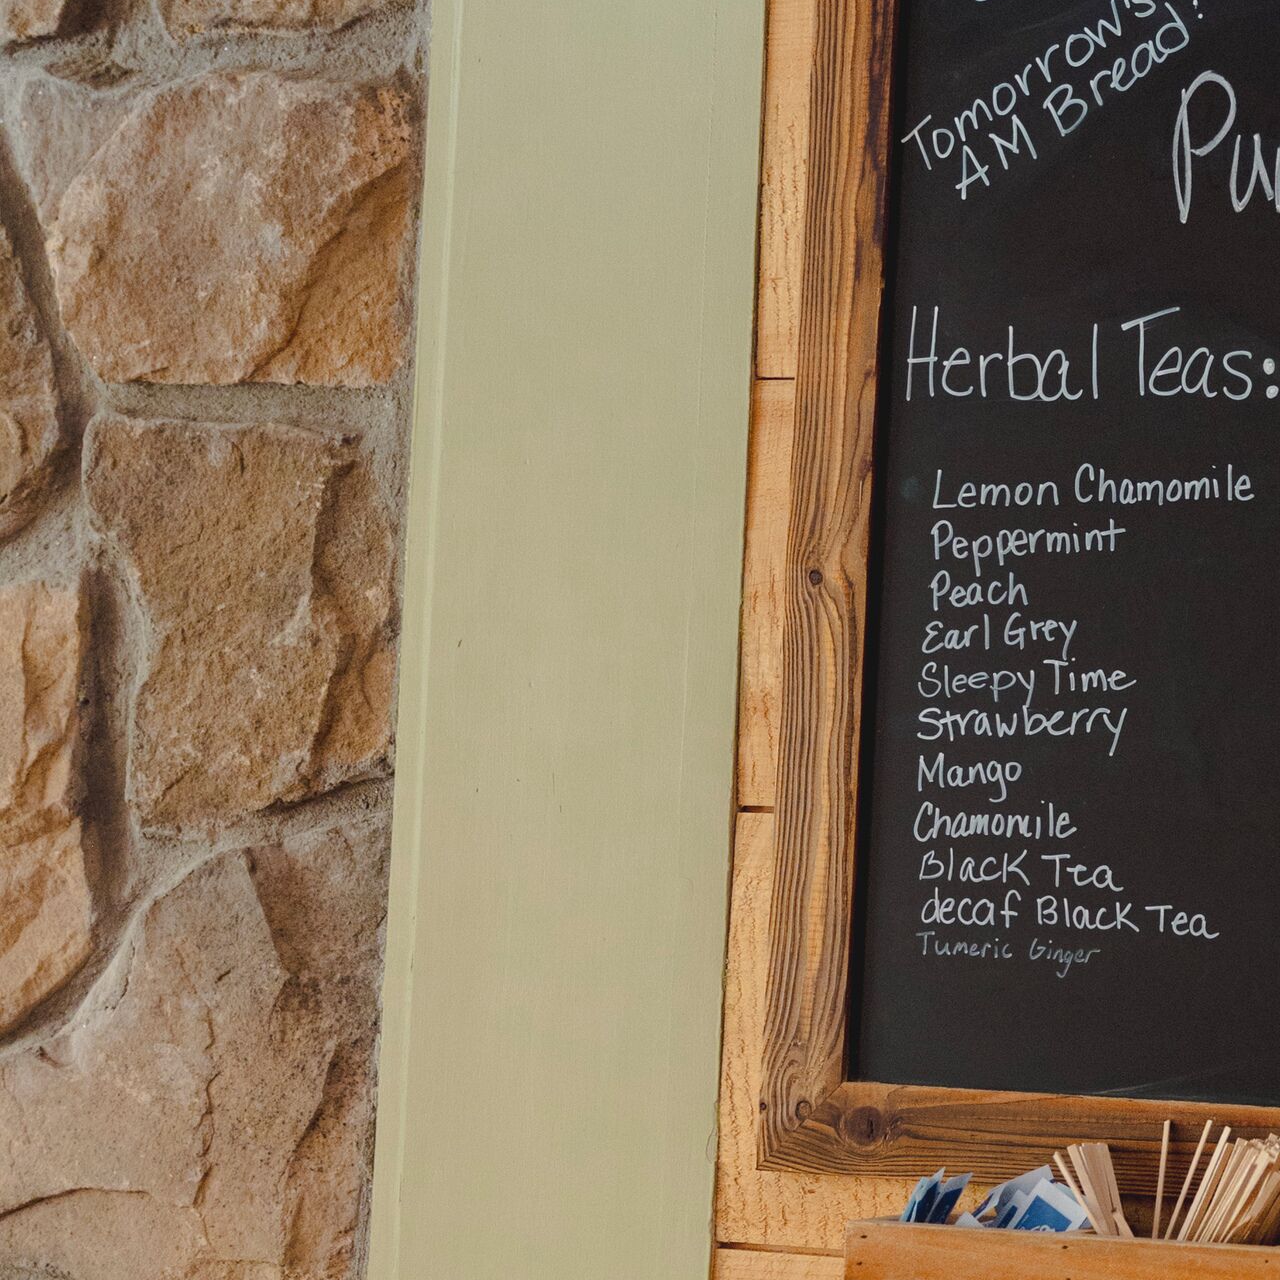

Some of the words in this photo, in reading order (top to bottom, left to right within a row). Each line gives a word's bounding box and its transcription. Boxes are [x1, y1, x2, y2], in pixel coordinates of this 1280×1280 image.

[954, 124, 1039, 200] AM
[904, 304, 1099, 402] Herbal
[1120, 306, 1280, 400] Teas:
[931, 468, 1060, 509] Lemon
[1073, 462, 1255, 506] Chamomile
[930, 518, 1127, 577] Peppermint
[928, 569, 1029, 612] Peach
[920, 613, 991, 654] Earl
[1002, 611, 1078, 660] Grey
[917, 661, 1036, 708] Sleepy
[1042, 657, 1137, 695] Time
[916, 705, 1128, 757] Strawberry
[917, 752, 1023, 803] Mango
[919, 847, 1031, 886] Black
[1040, 853, 1125, 892] Tea
[920, 886, 1022, 928] decaf
[1035, 895, 1140, 933] Black
[1144, 904, 1220, 940] Tea
[915, 931, 1013, 960] Tumeric
[1028, 937, 1102, 978] Ginger
